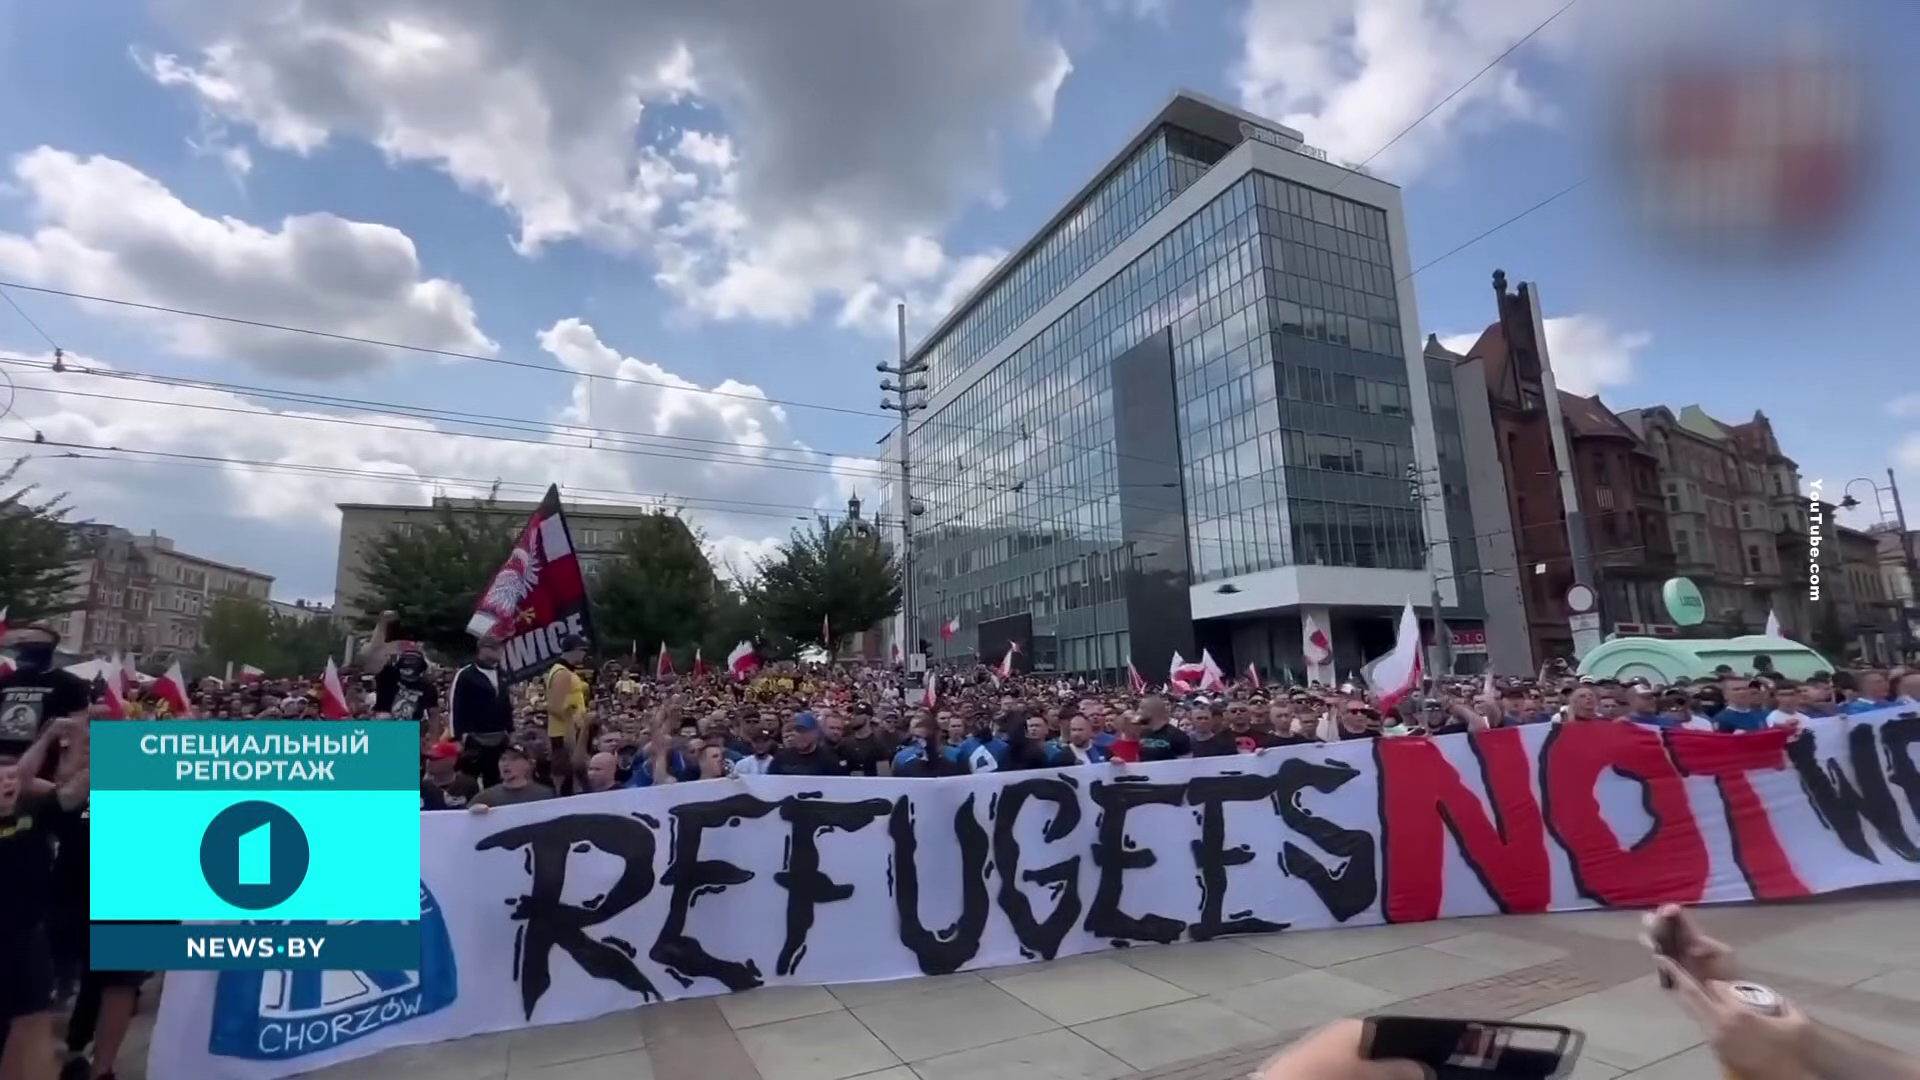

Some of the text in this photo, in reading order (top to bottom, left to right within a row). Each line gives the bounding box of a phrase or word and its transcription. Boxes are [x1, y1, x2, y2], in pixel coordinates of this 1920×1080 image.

[500, 612, 583, 672] WICE
[475, 757, 1378, 1021] REFUGEES
[1373, 718, 1812, 924] NOT
[258, 994, 423, 1054] CHORZÓW
